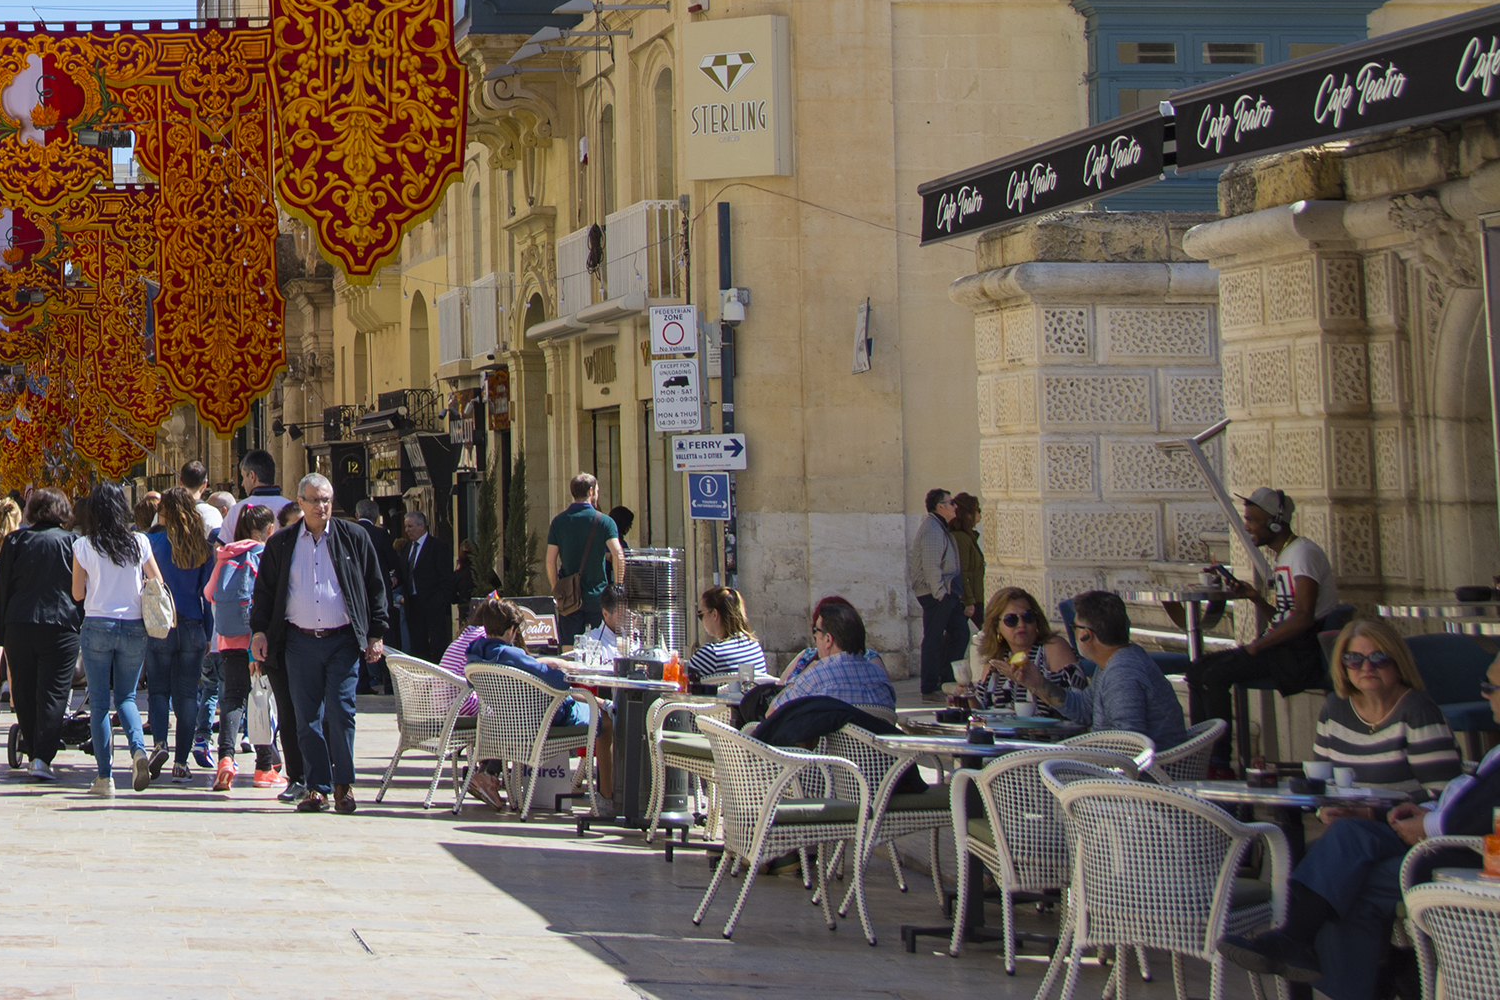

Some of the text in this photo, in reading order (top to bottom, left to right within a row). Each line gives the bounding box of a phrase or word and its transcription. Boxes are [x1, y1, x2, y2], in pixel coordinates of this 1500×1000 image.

[690, 100, 768, 136] STERLING
[1314, 62, 1406, 128] Cafe Teatro
[1197, 94, 1274, 153] Cafe Teatro
[1084, 135, 1142, 189] Cafe Teatro
[936, 186, 983, 232] Cafe Teatro
[1006, 163, 1057, 213] Cafe Teatro
[348, 461, 359, 473] 12
[689, 441, 722, 449] FERRY
